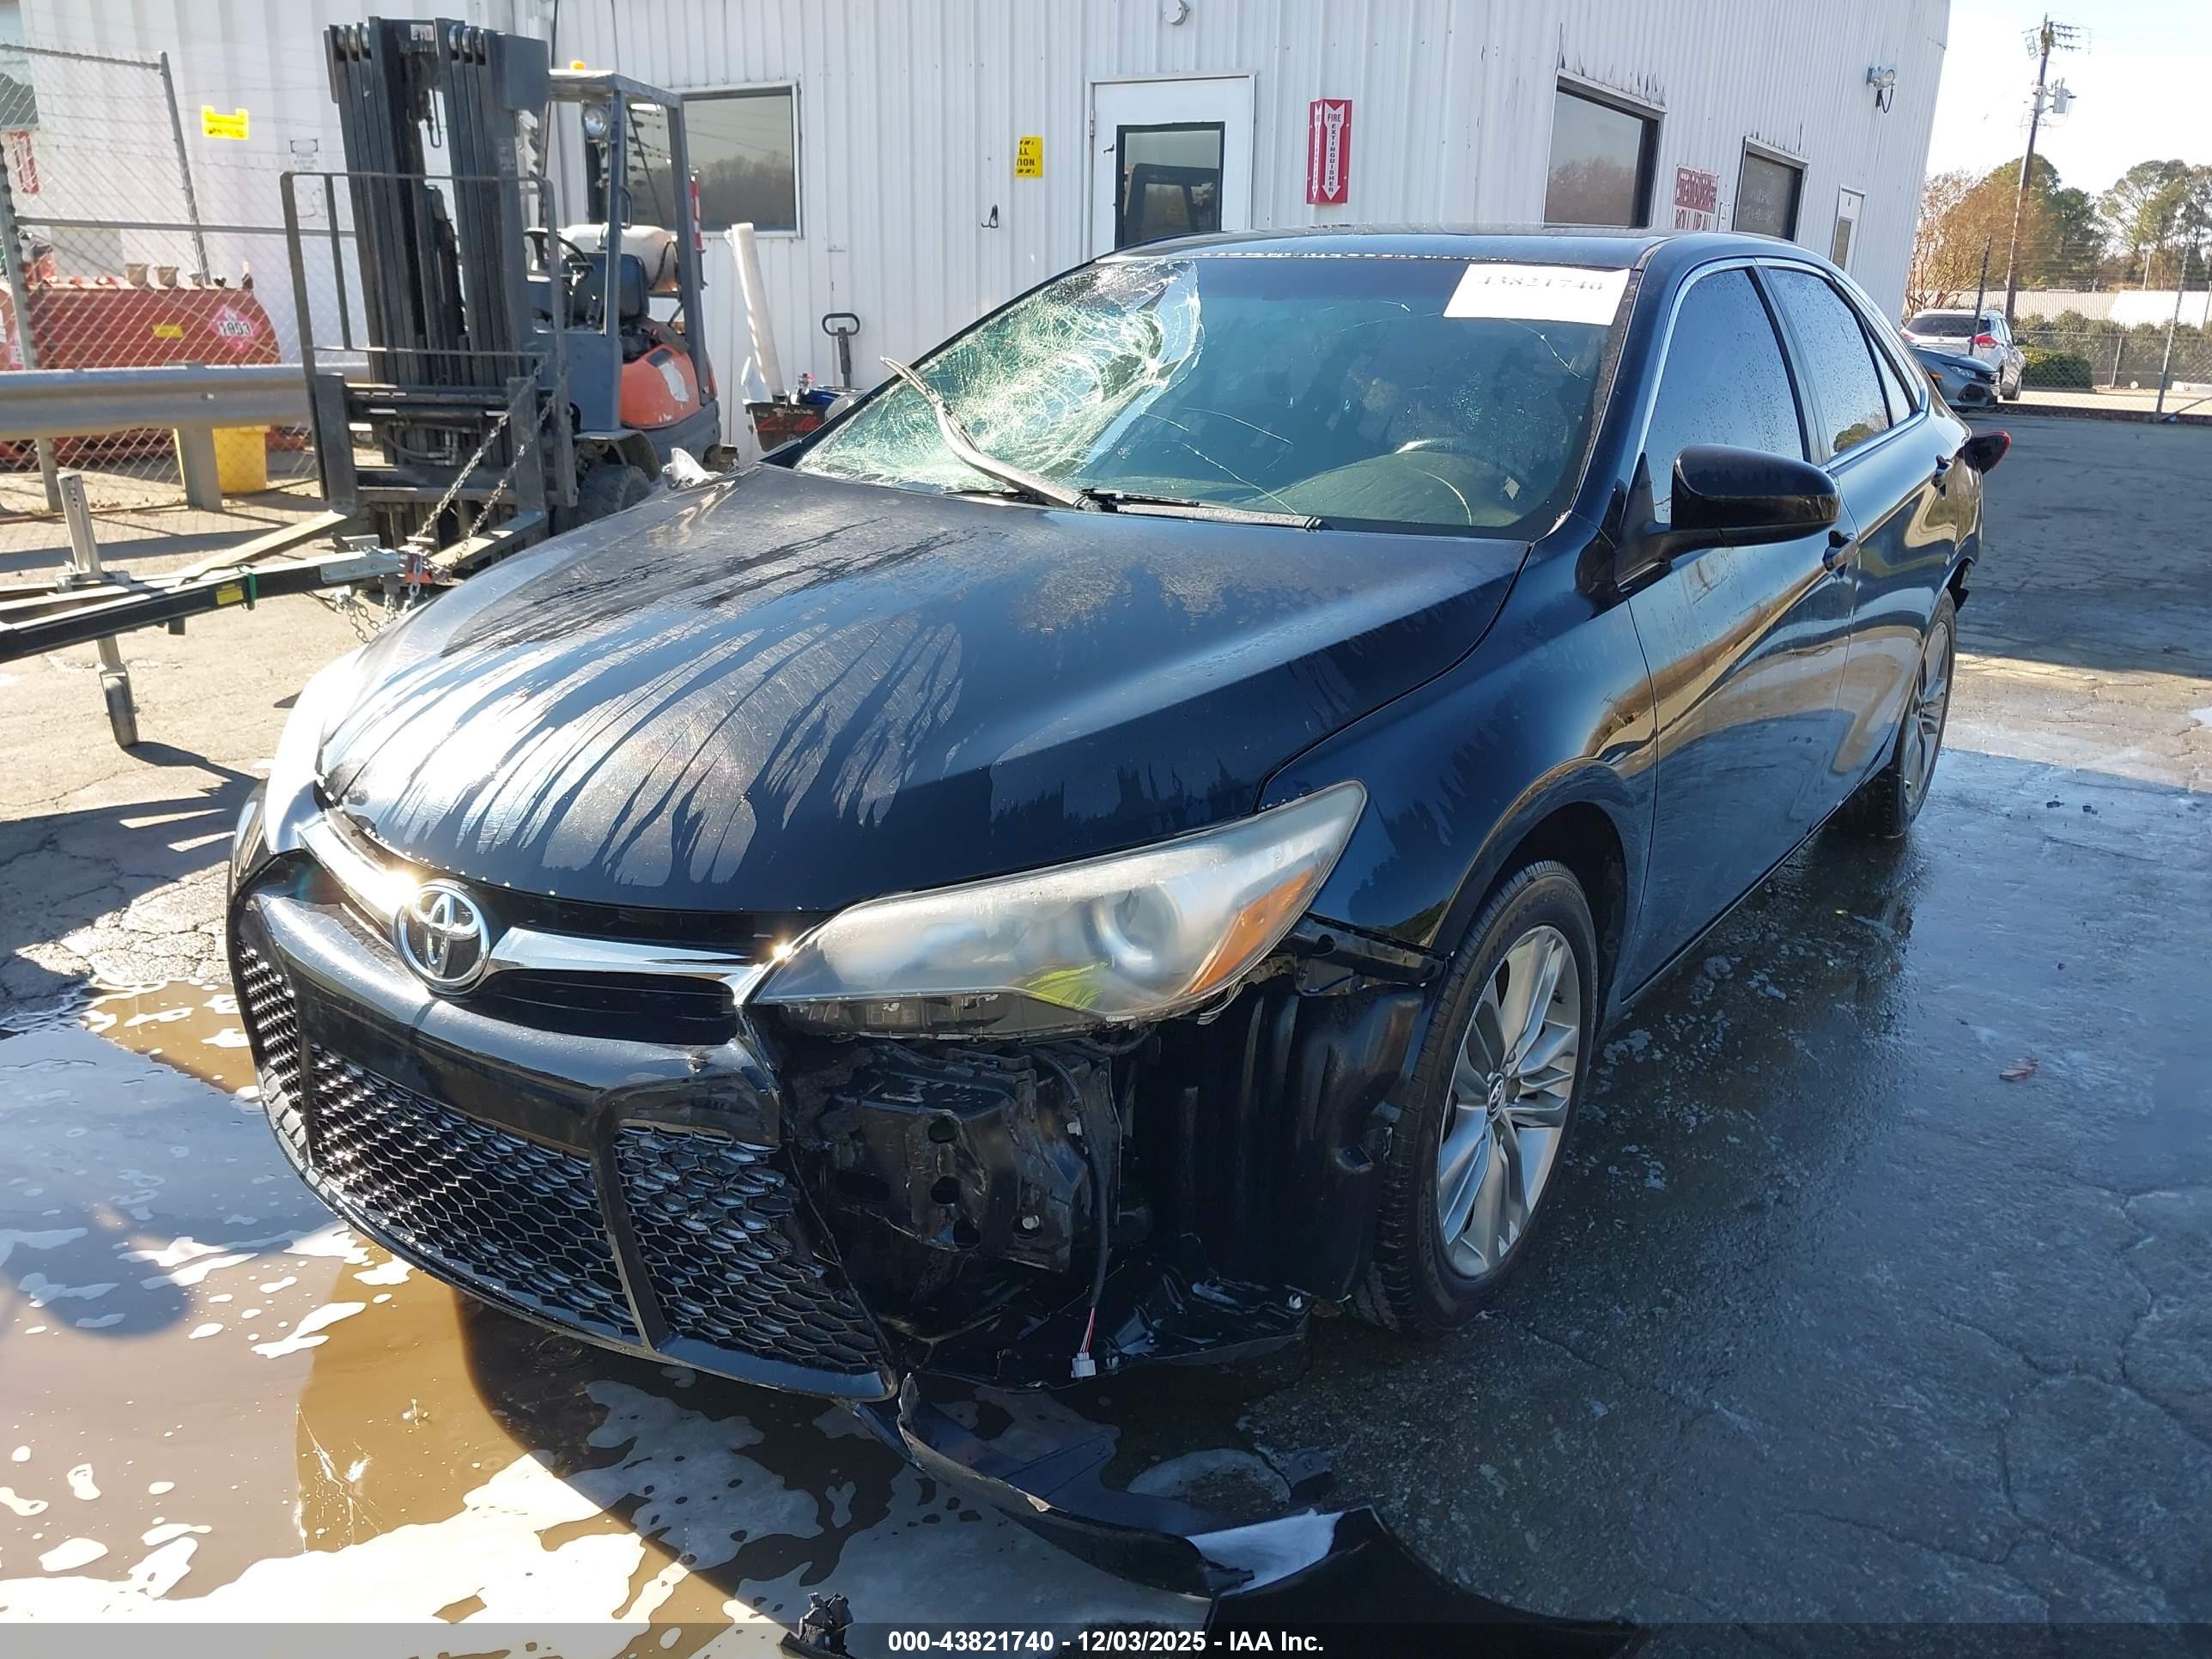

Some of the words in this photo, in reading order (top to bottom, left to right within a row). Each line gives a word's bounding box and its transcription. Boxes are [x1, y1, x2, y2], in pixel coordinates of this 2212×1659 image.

[1327, 113, 1341, 122] FIRE
[1328, 123, 1337, 193] EXTINGUISHER
[1478, 275, 1604, 291] 43821740
